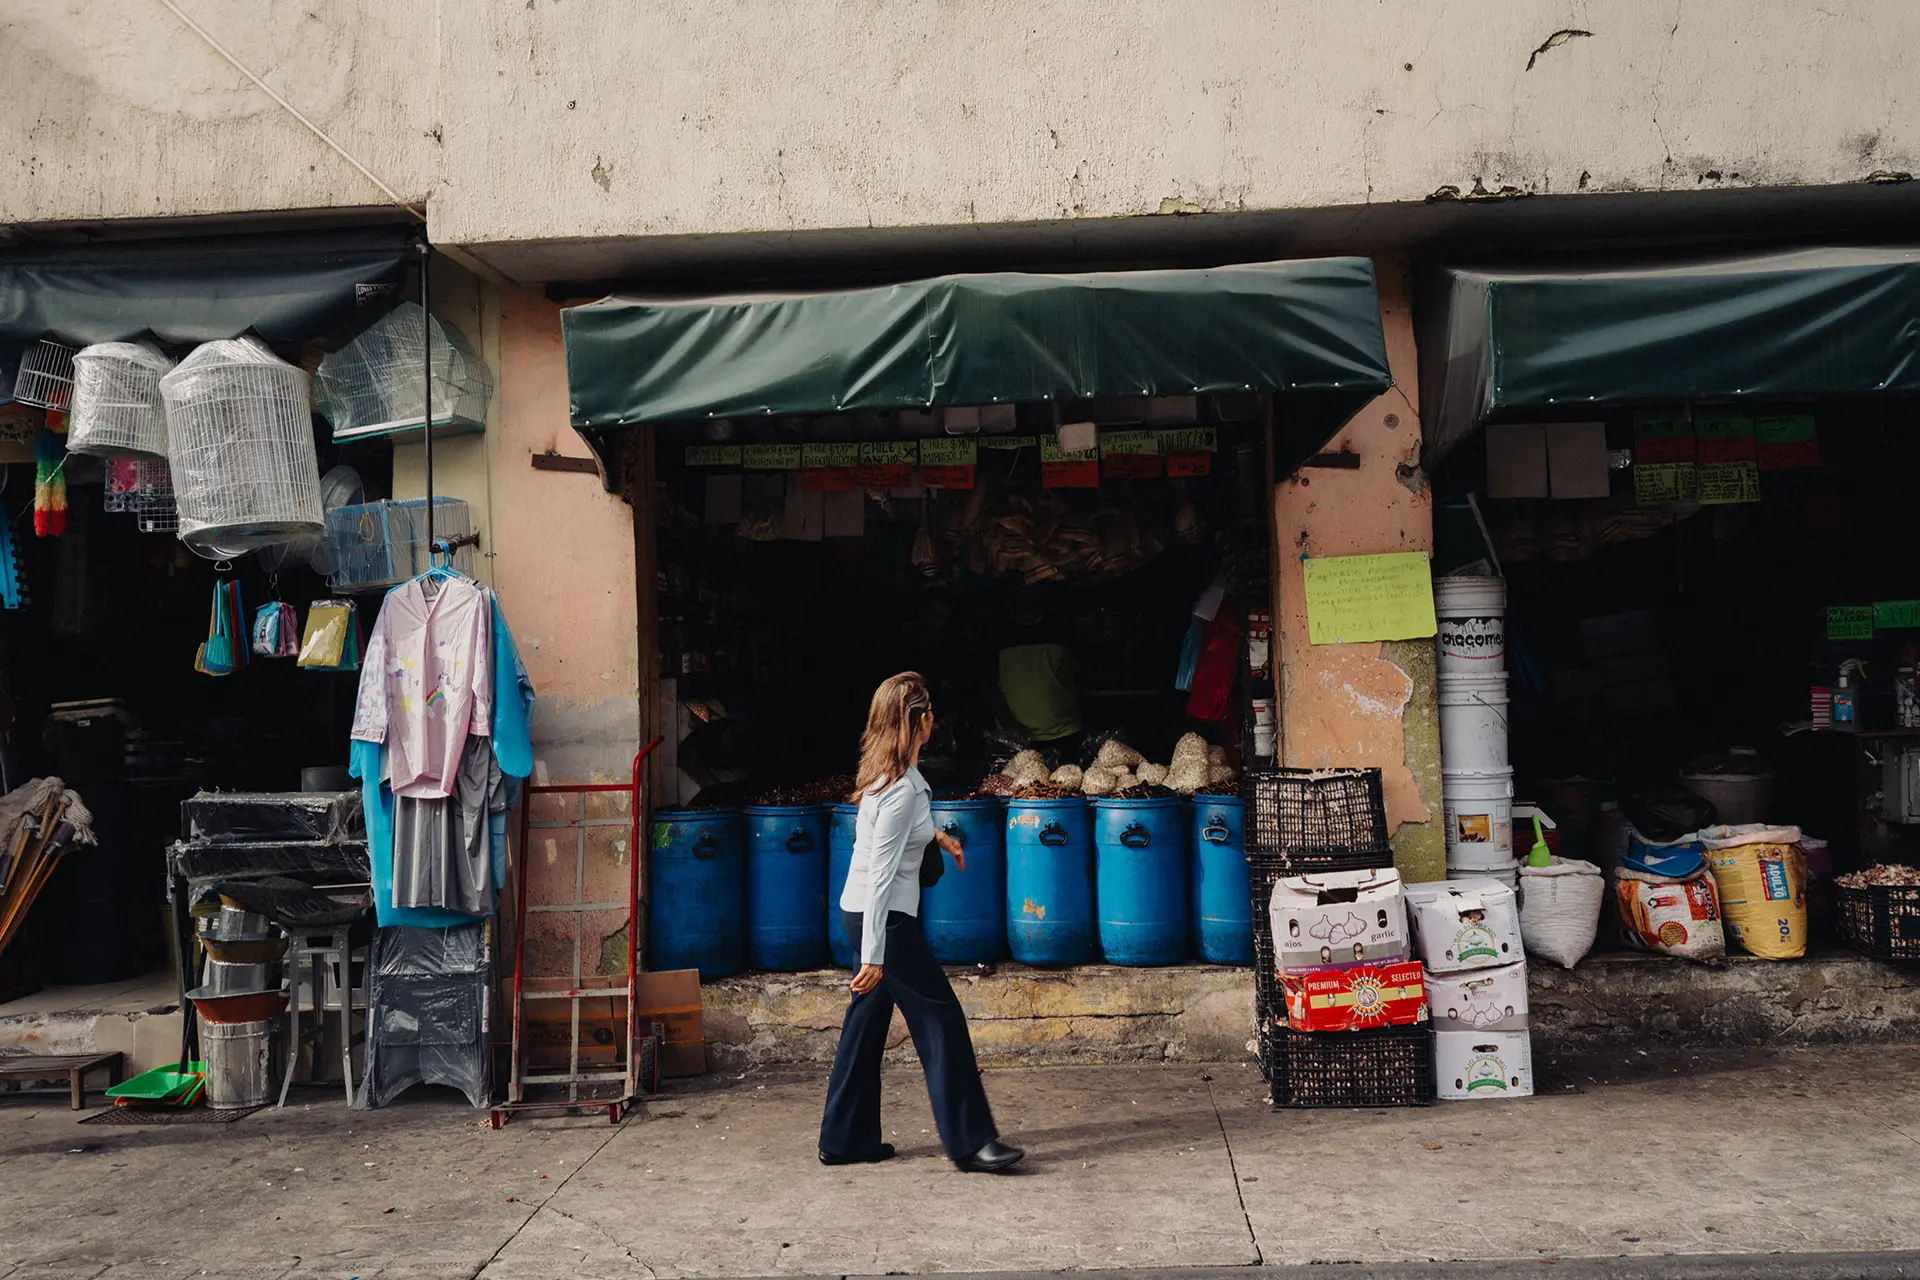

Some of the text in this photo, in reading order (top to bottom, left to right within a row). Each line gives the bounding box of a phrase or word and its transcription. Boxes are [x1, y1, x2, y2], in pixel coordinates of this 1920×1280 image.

[861, 443, 893, 455] CHILE
[1768, 863, 1785, 898] ADULTO
[1778, 918, 1790, 935] 20
[1371, 929, 1395, 943] garlic
[1284, 940, 1302, 950] ajos
[1391, 971, 1421, 983] SELECTED
[1308, 980, 1340, 991] PREMIUM
[1475, 1053, 1507, 1070] SUPREMO
